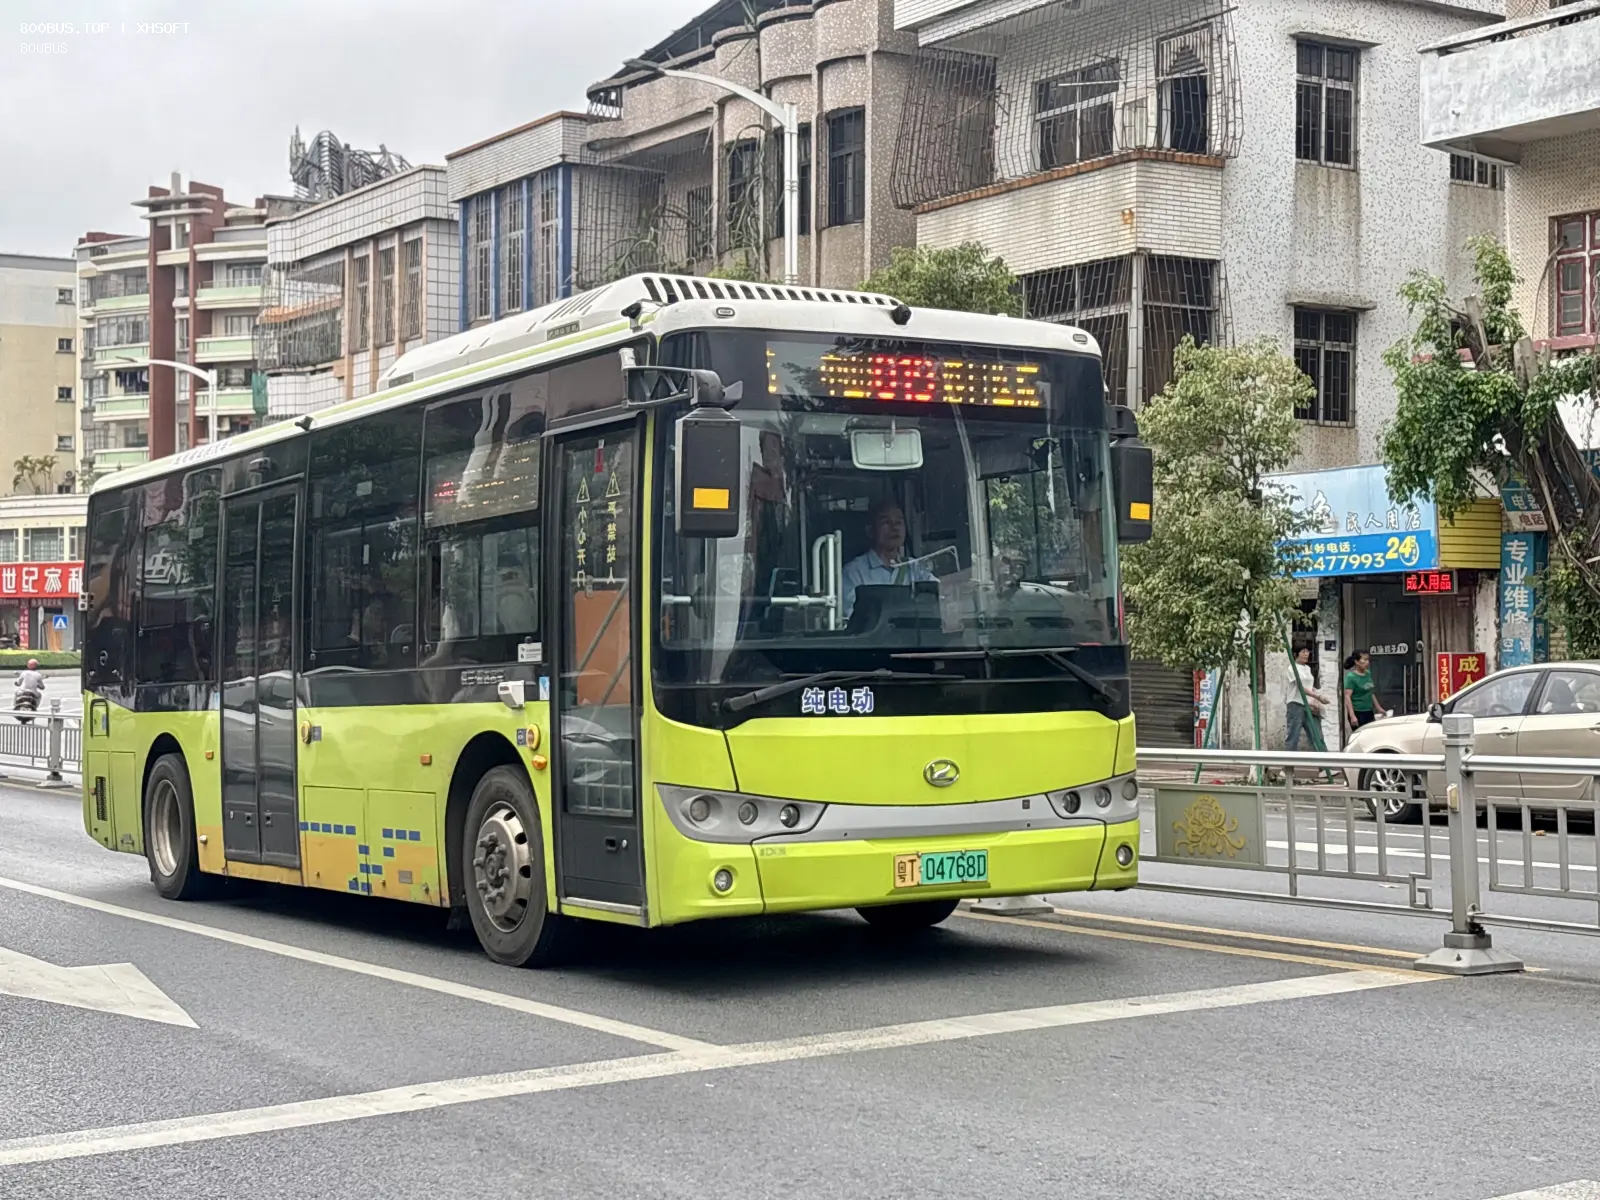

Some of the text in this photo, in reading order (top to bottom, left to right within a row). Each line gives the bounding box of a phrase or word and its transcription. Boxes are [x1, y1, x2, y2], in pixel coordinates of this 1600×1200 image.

[1385, 535, 1412, 559] 24
[1406, 574, 1452, 591] 成人用品
[1504, 540, 1530, 624] 专业维修
[802, 686, 874, 714] 纯电动
